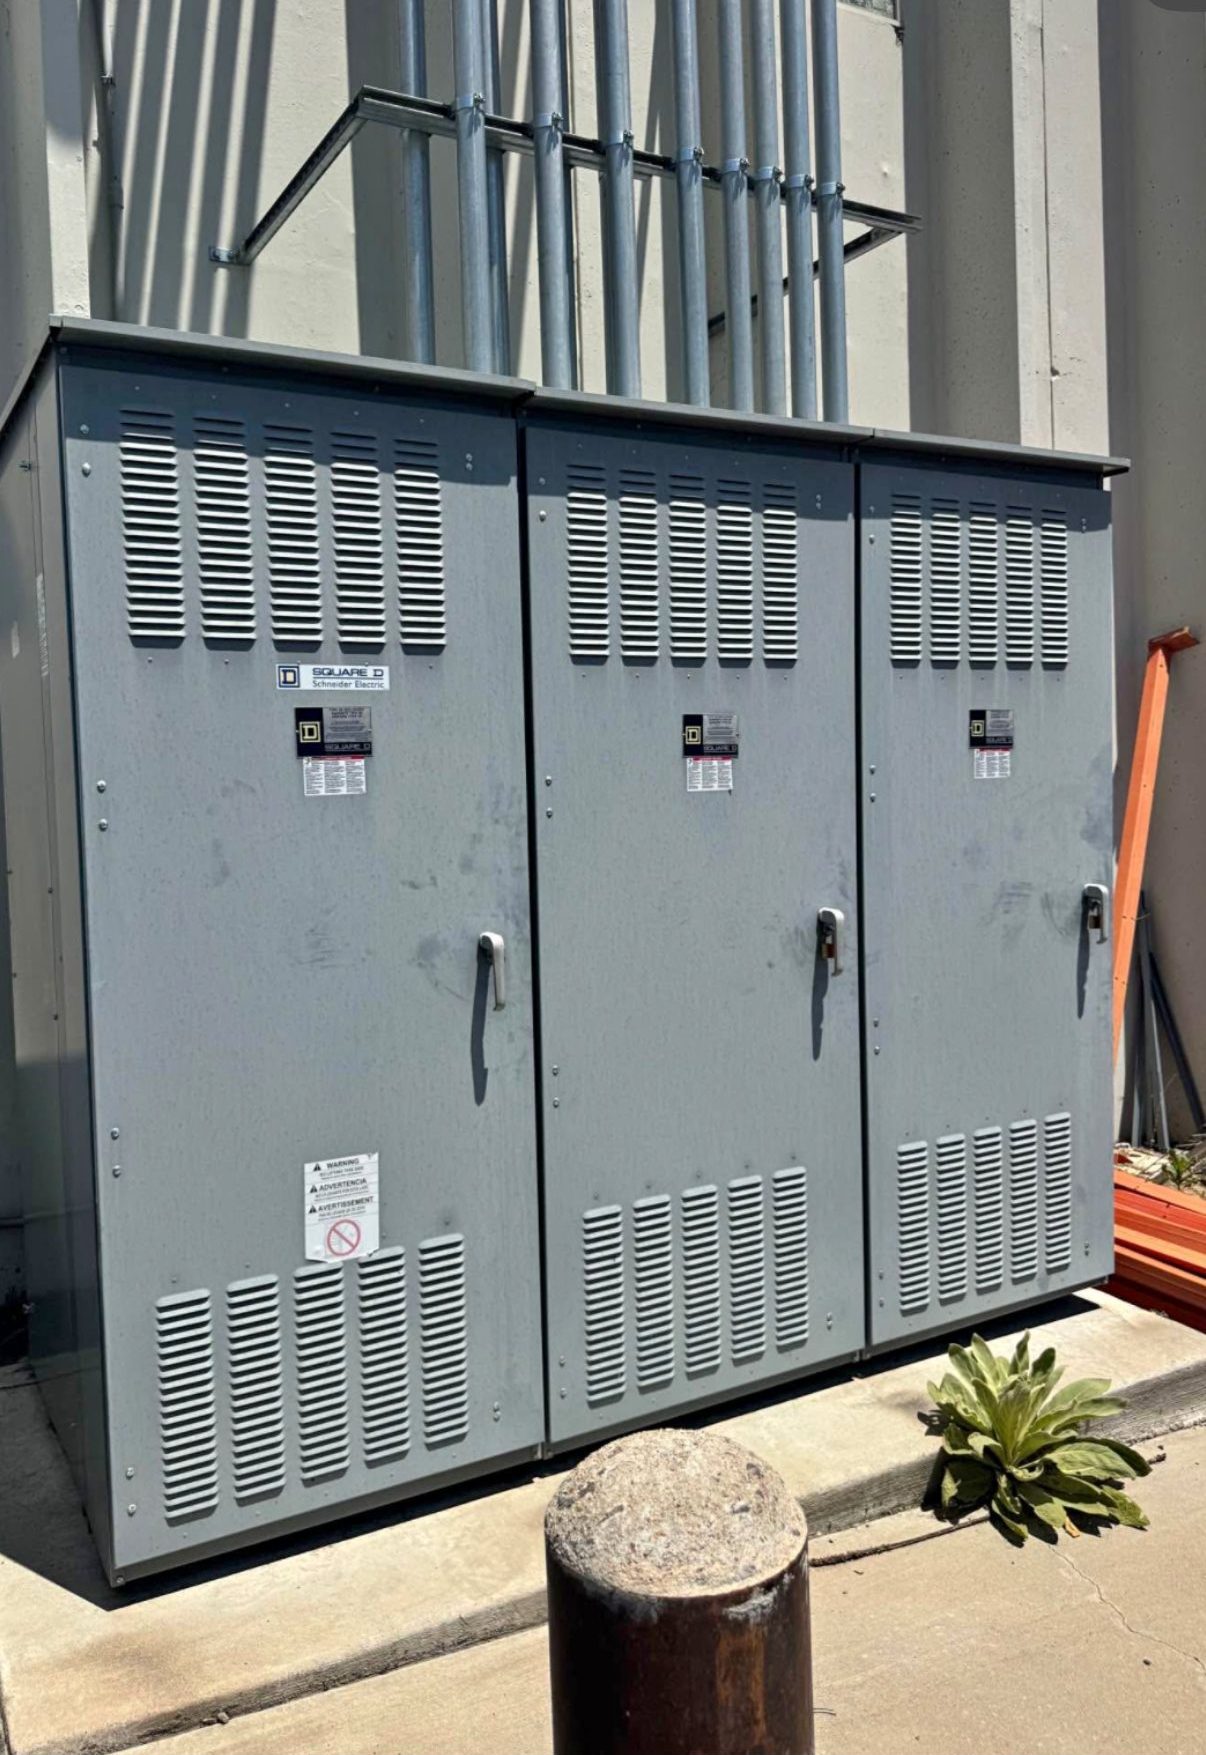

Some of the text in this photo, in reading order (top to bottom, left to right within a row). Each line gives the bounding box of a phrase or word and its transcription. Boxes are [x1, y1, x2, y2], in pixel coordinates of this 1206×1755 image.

[281, 669, 296, 685] D
[312, 667, 384, 677] SQUARE D
[312, 680, 384, 689] Schneider Electric
[326, 1158, 360, 1168] WARNING
[319, 1178, 367, 1191] ADVERTENCIA
[318, 1196, 374, 1211] AVERTISSEMENT
